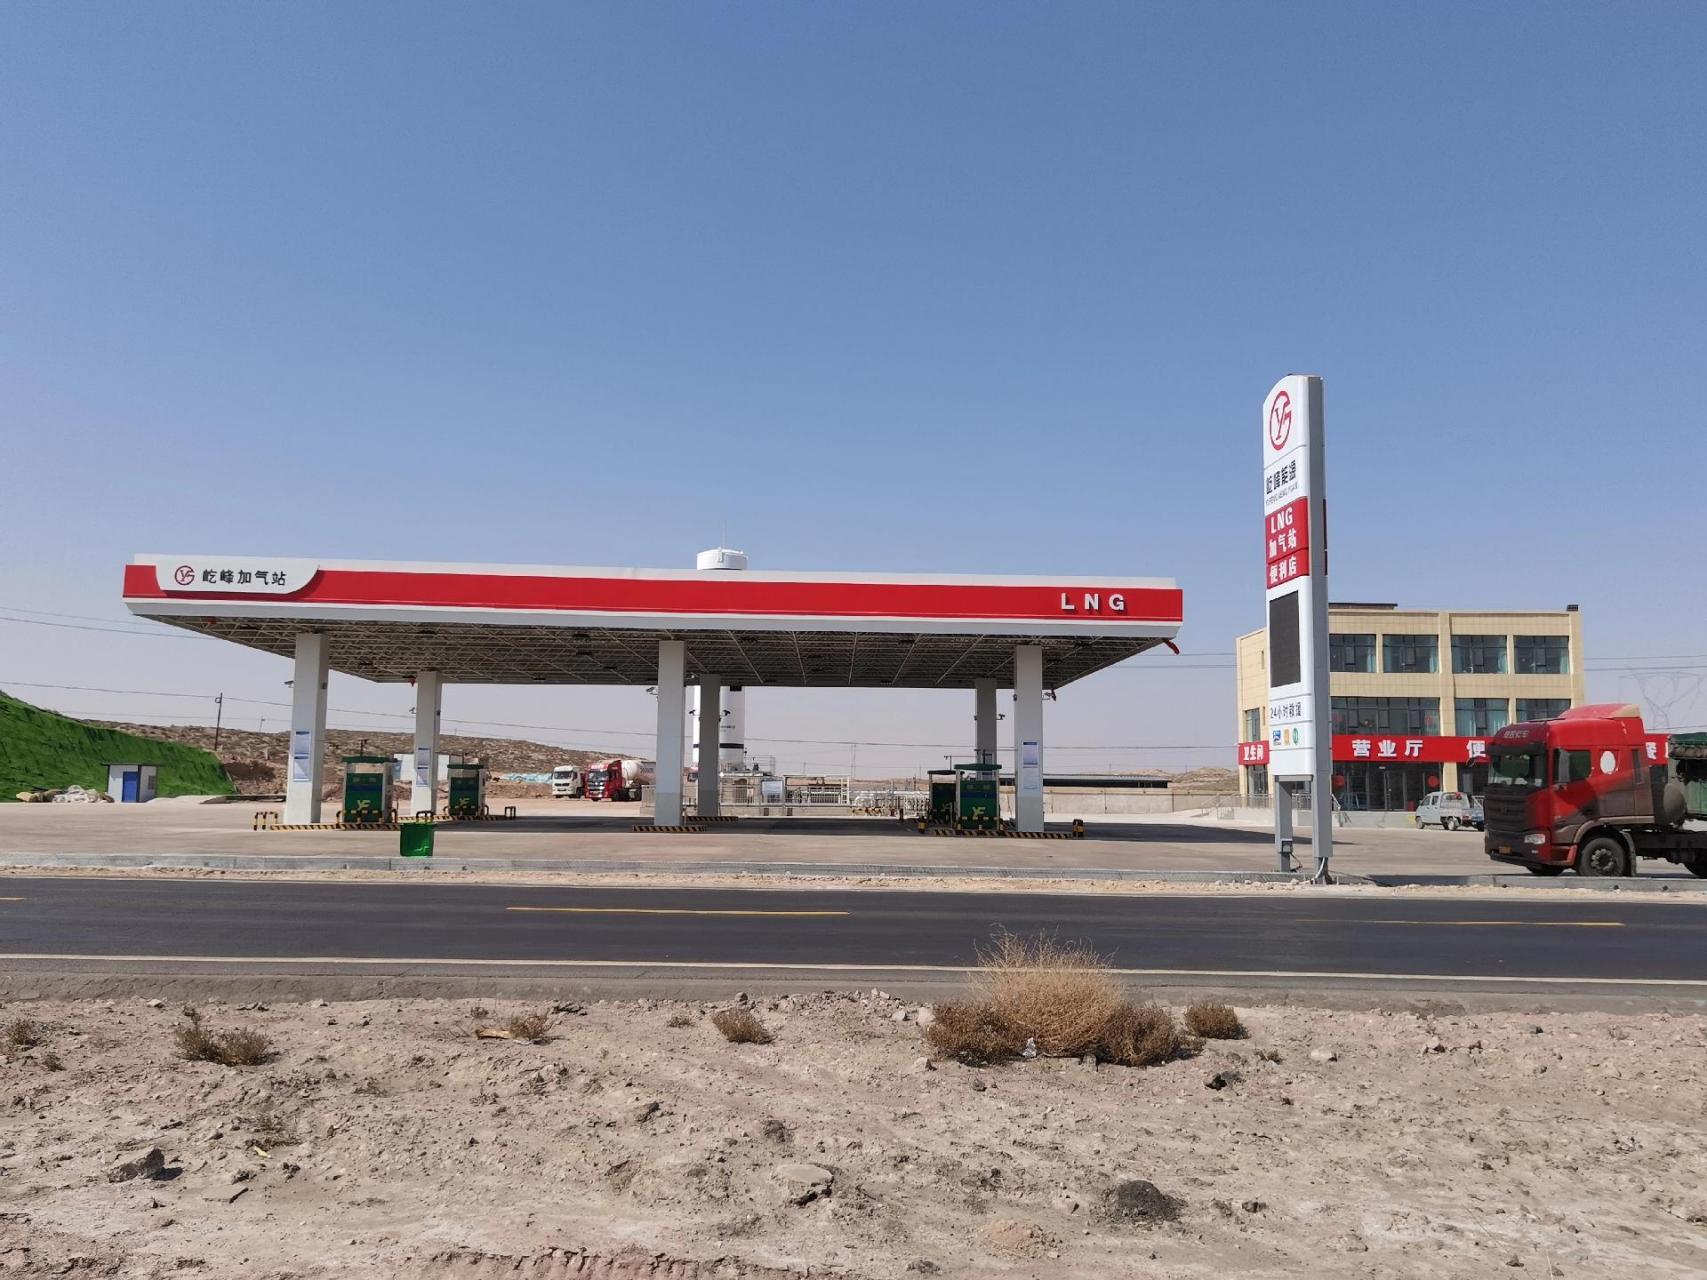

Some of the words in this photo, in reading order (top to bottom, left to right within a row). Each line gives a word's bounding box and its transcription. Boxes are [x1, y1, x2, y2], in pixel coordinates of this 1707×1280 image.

[1271, 507, 1293, 534] LNG
[1269, 528, 1296, 558] 加气站
[202, 569, 287, 586] 屹峰加气站
[1270, 556, 1296, 584] 便利店
[1061, 593, 1125, 611] LNG
[1243, 744, 1264, 761] 卫生间
[1352, 739, 1423, 758] 营业厅
